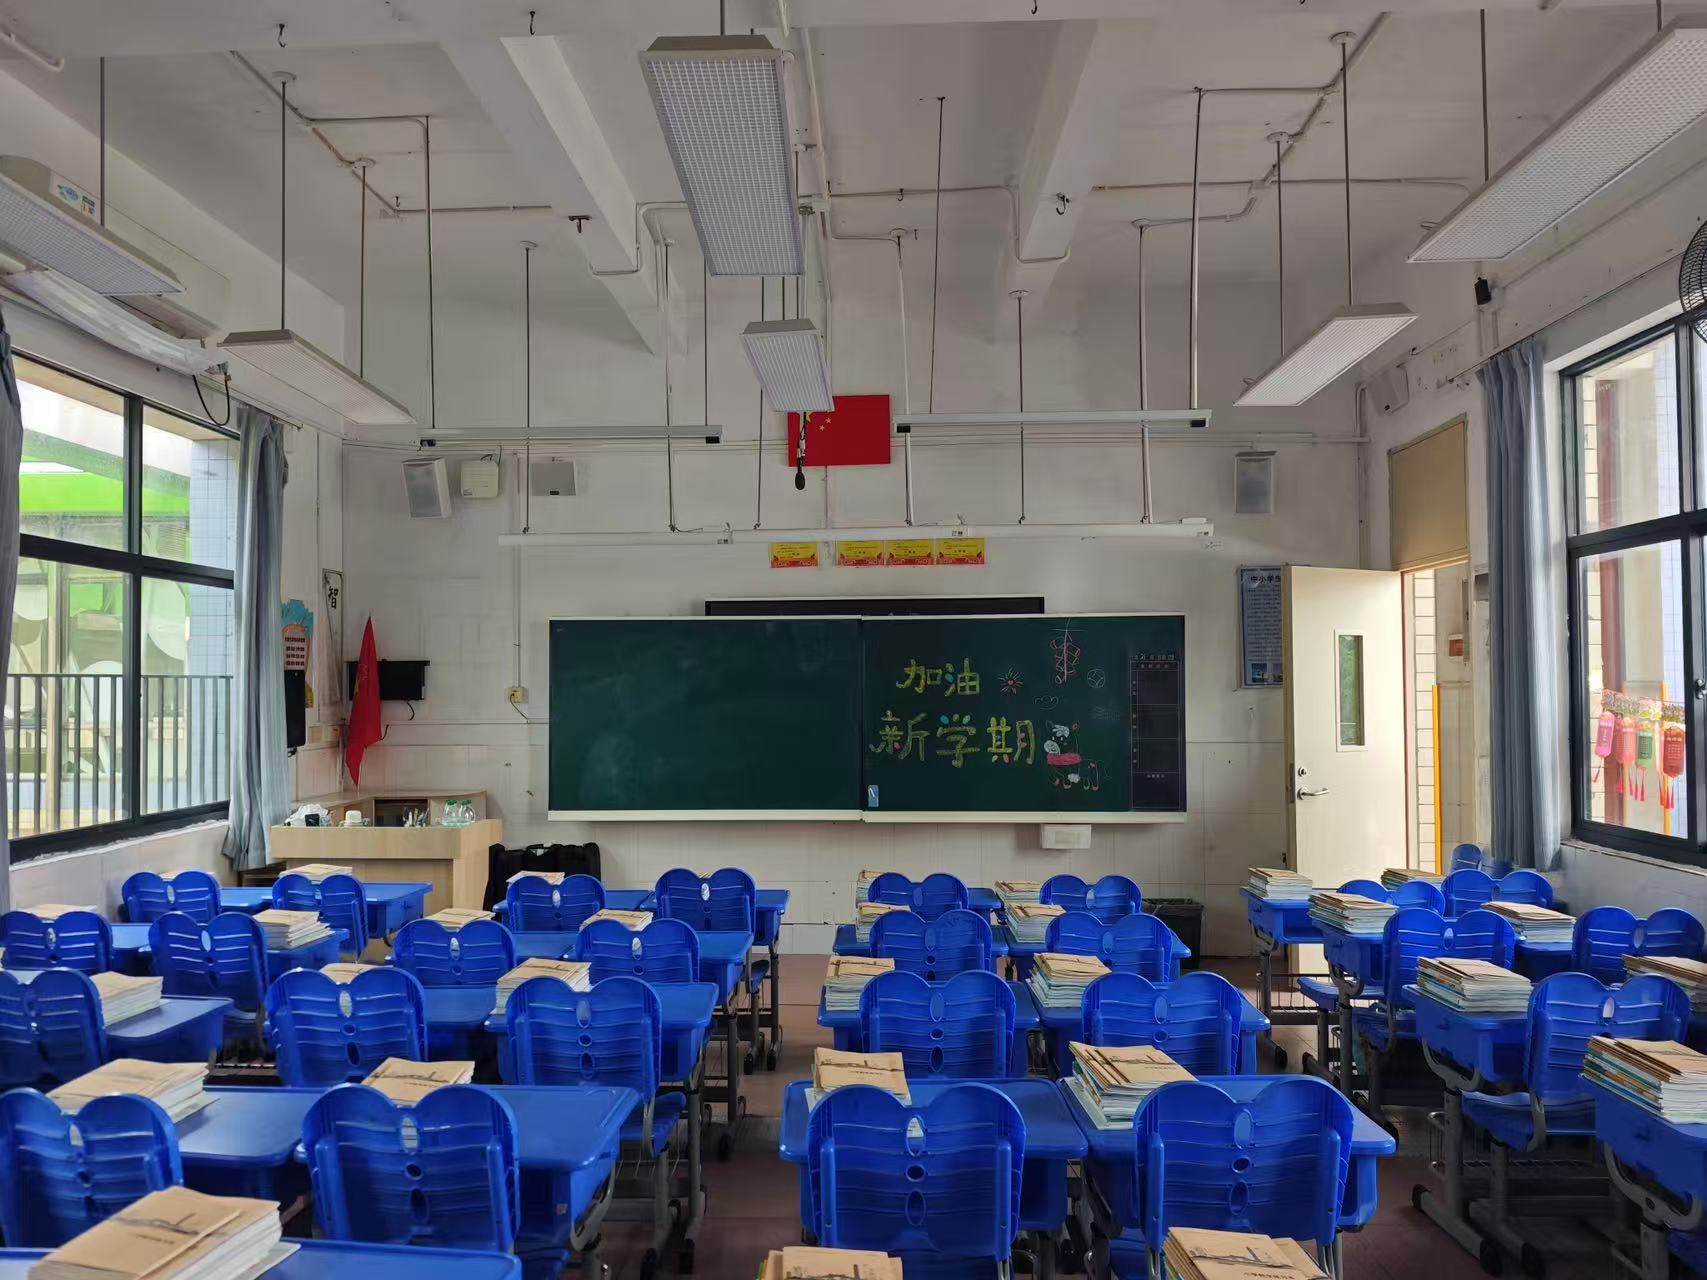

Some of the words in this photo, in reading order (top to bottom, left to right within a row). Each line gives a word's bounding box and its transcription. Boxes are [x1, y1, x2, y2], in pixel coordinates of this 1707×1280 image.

[896, 657, 980, 697] 加油
[868, 709, 1036, 769] 新学期
